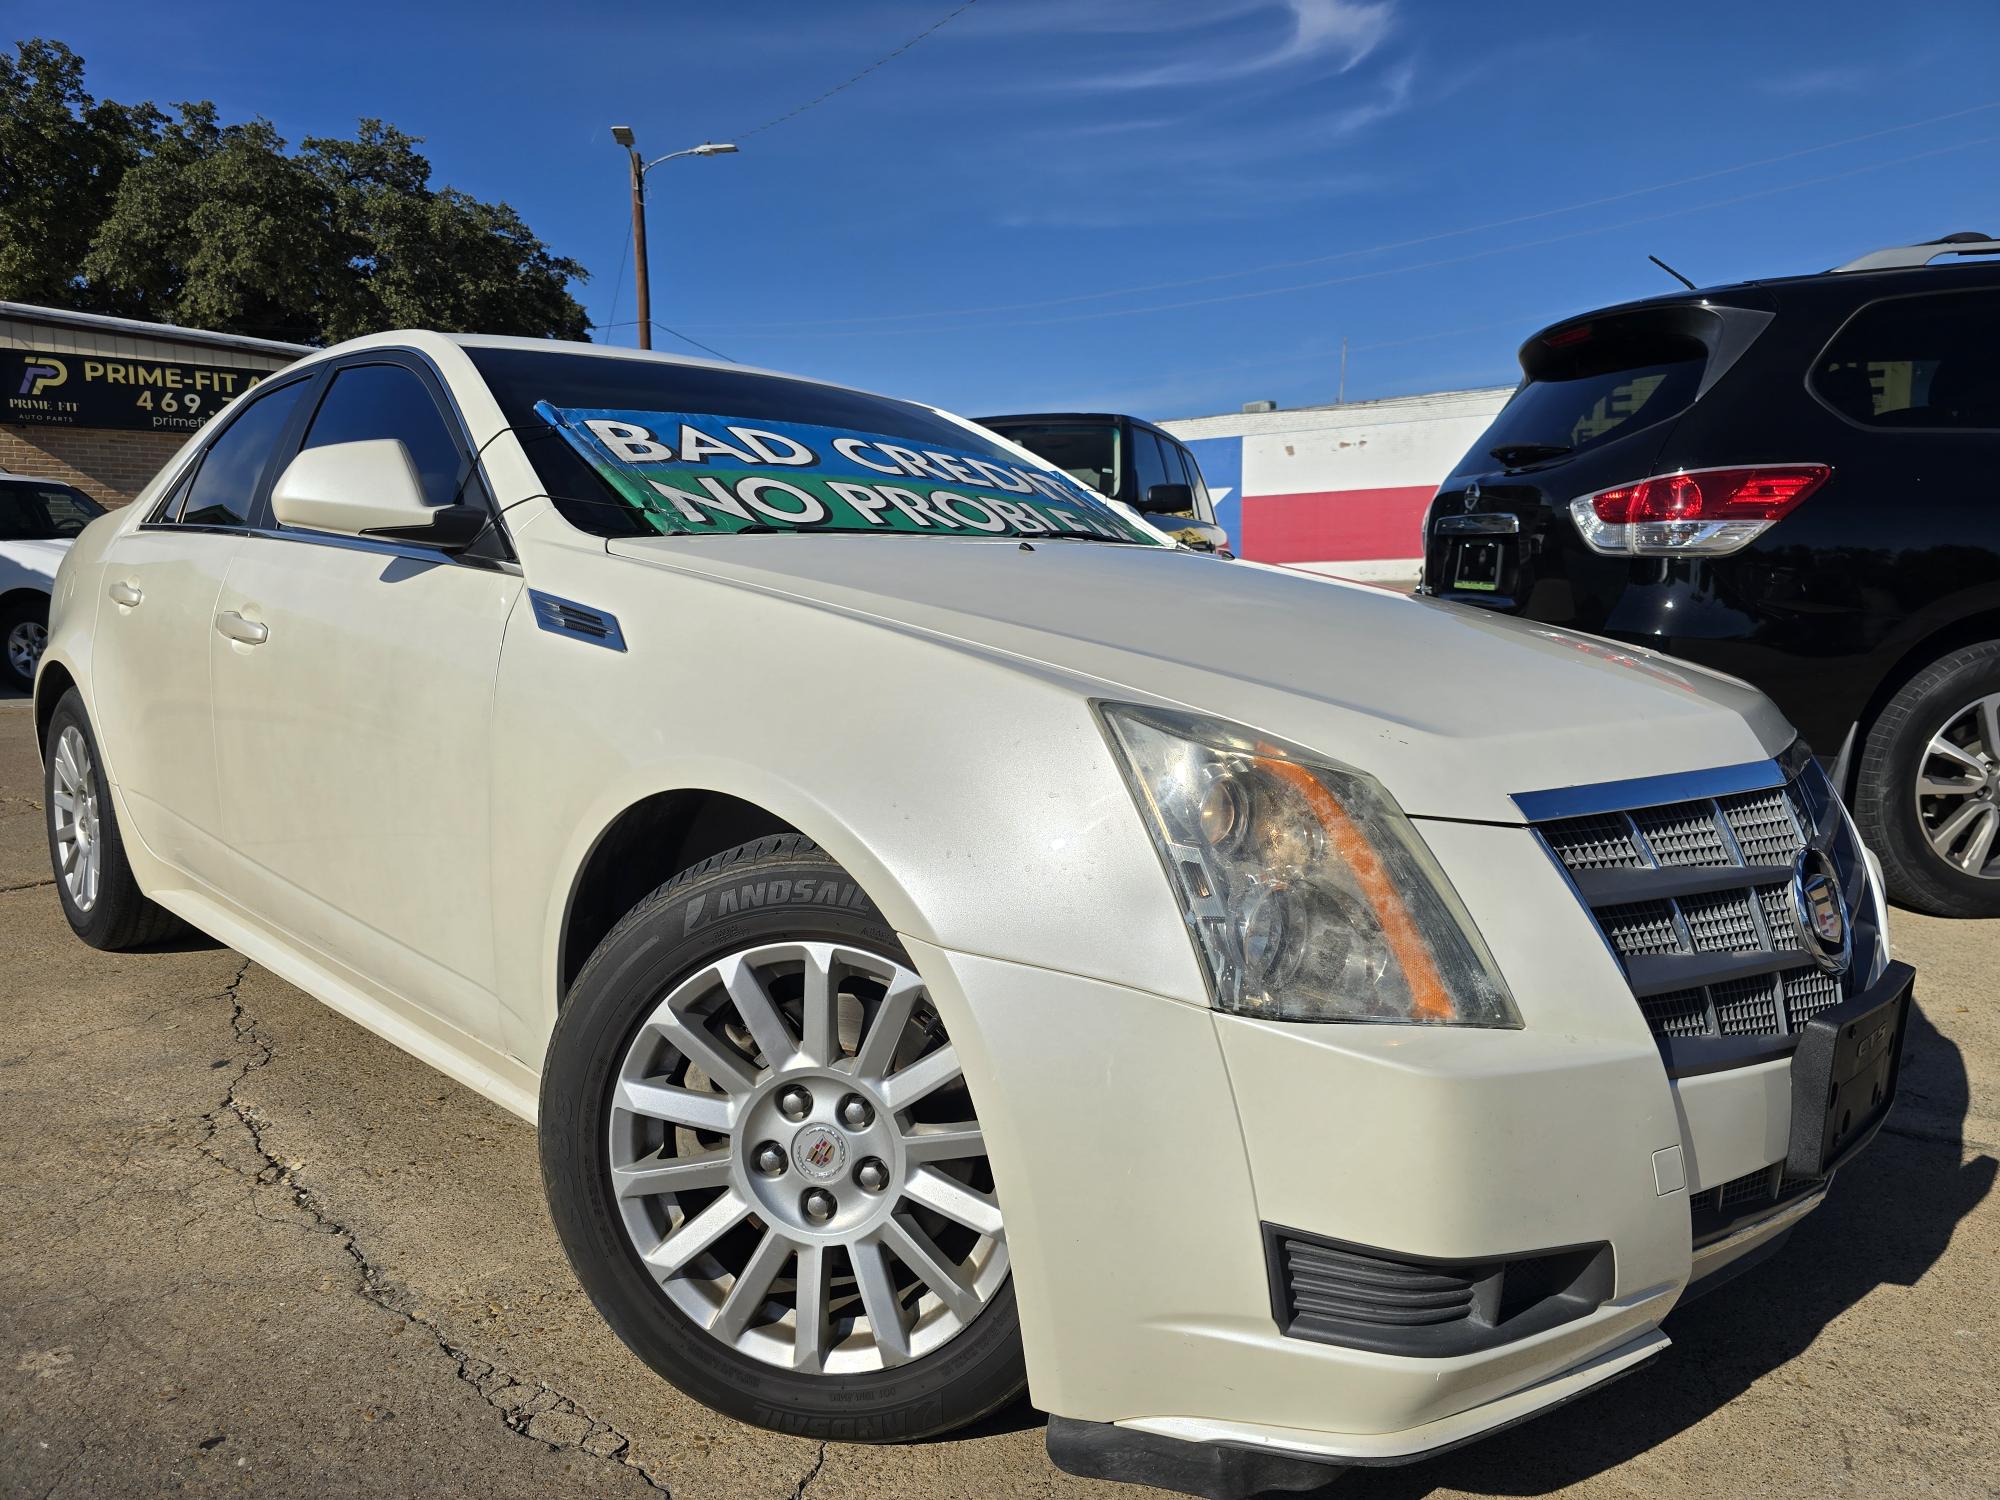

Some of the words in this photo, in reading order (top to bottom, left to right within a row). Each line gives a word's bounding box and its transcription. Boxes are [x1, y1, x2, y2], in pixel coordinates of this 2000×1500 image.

[84, 361, 238, 393] PRIME-FIT
[9, 398, 53, 410] PRIME
[58, 401, 79, 412] FIT
[136, 390, 234, 414] 469.
[46, 415, 73, 423] PARTS
[584, 419, 814, 466] BAD
[832, 438, 1087, 508] CREDIT
[648, 477, 826, 523] NO
[683, 879, 871, 938] LANDSAIL
